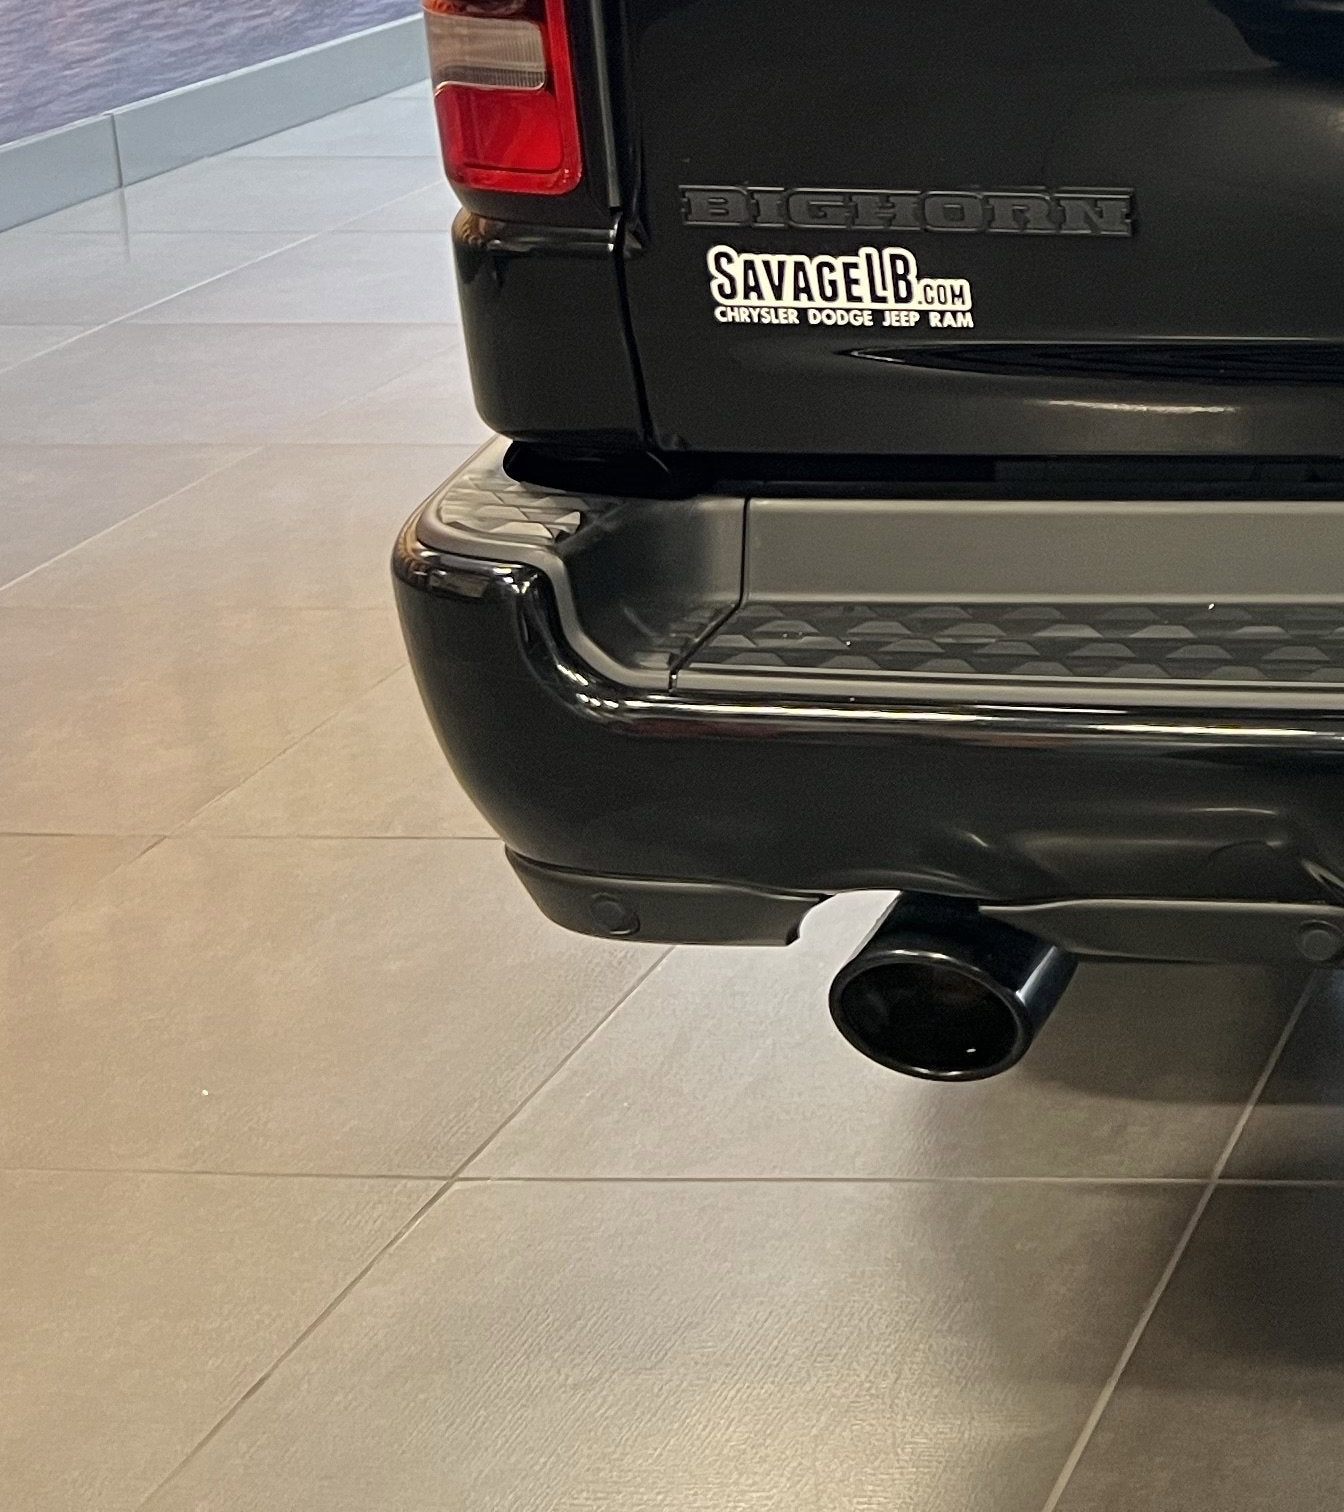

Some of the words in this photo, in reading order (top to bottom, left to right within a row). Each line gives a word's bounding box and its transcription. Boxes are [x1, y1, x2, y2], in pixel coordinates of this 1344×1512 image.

[680, 183, 1134, 236] BIGHORN
[714, 305, 800, 324] CHRYSLER
[807, 308, 874, 326] DODGE
[881, 309, 920, 327] JEEP
[929, 311, 974, 328] RAM
